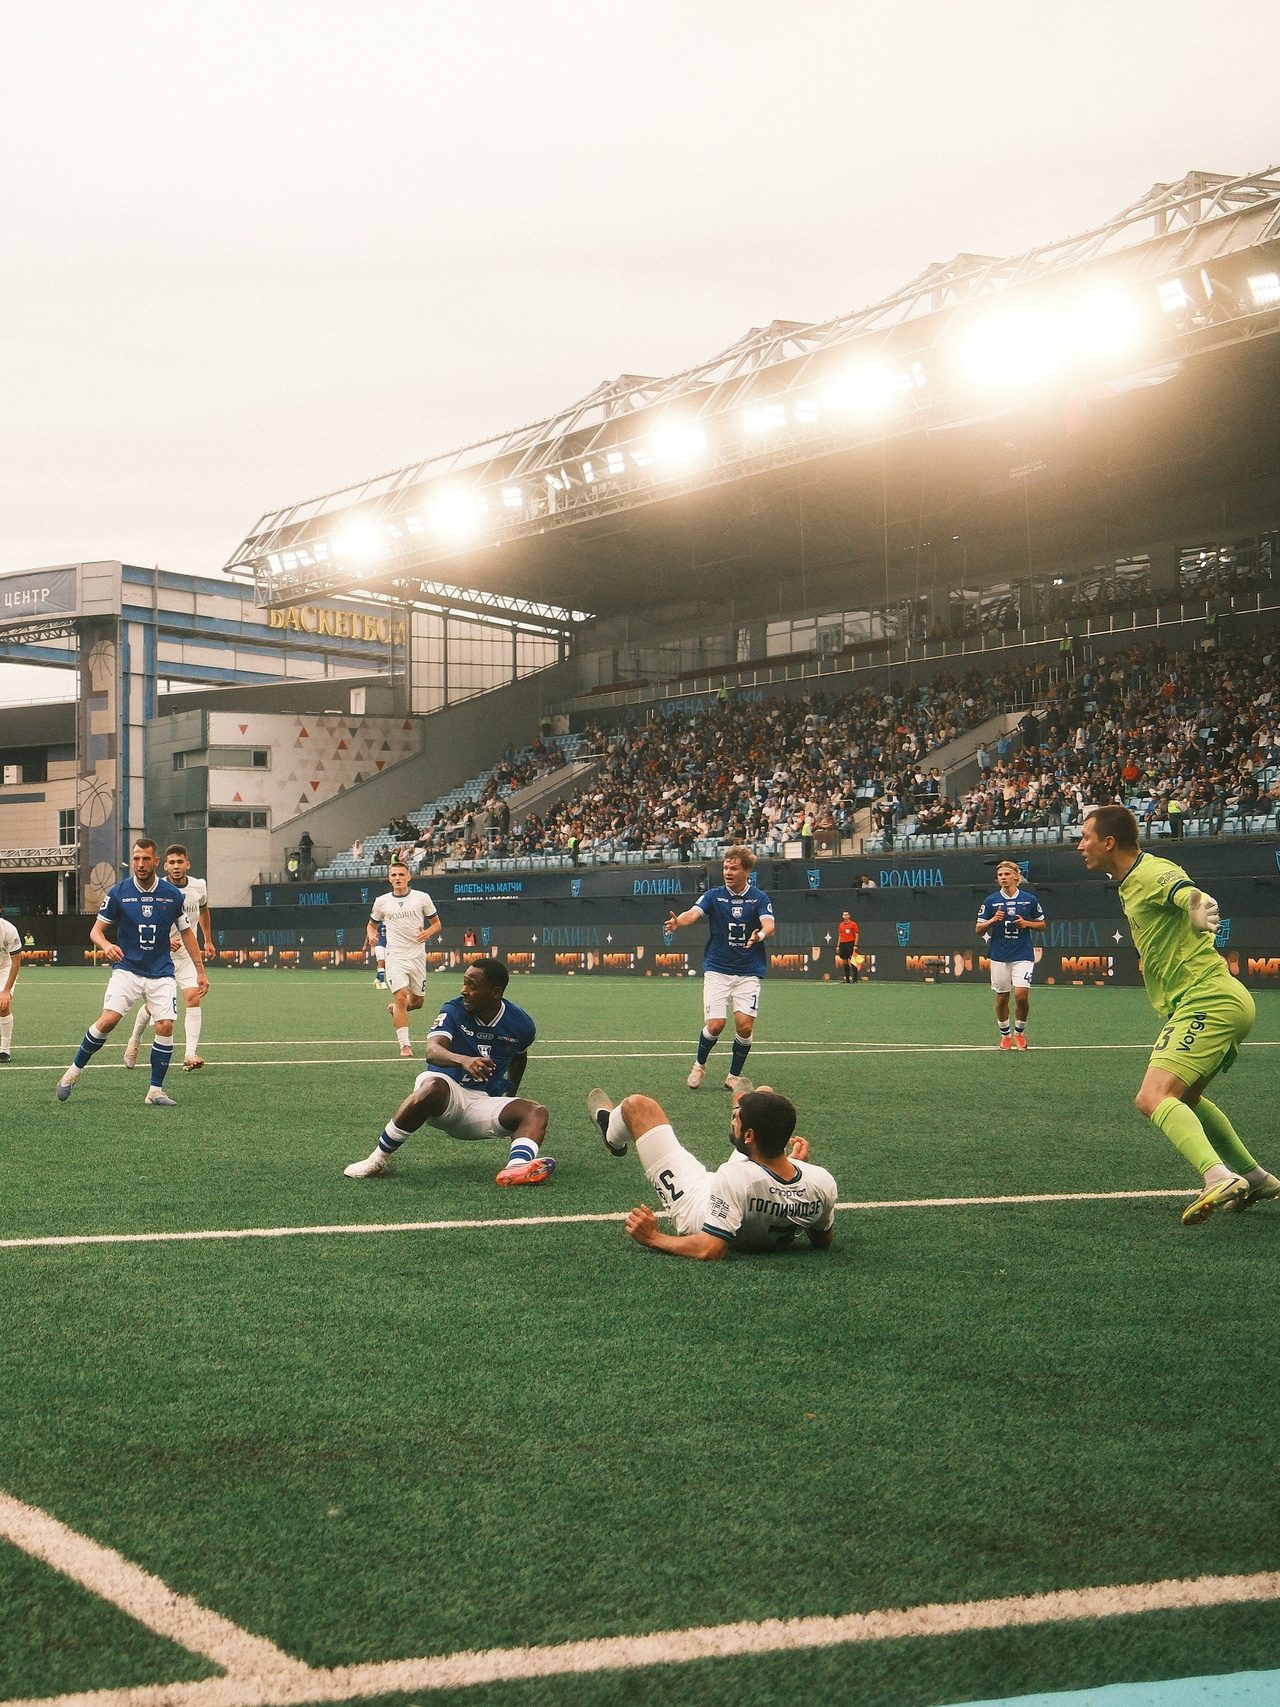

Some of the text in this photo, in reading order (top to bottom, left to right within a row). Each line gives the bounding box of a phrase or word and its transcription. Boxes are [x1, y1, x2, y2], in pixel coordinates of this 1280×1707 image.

[4, 588, 50, 608] ЦЕНТР
[453, 882, 522, 894] БИЛЕТЫ НА МАТЧИ
[659, 1169, 685, 1201] 3
[749, 1198, 821, 1218] ГОГЛИЧИДЗЕ
